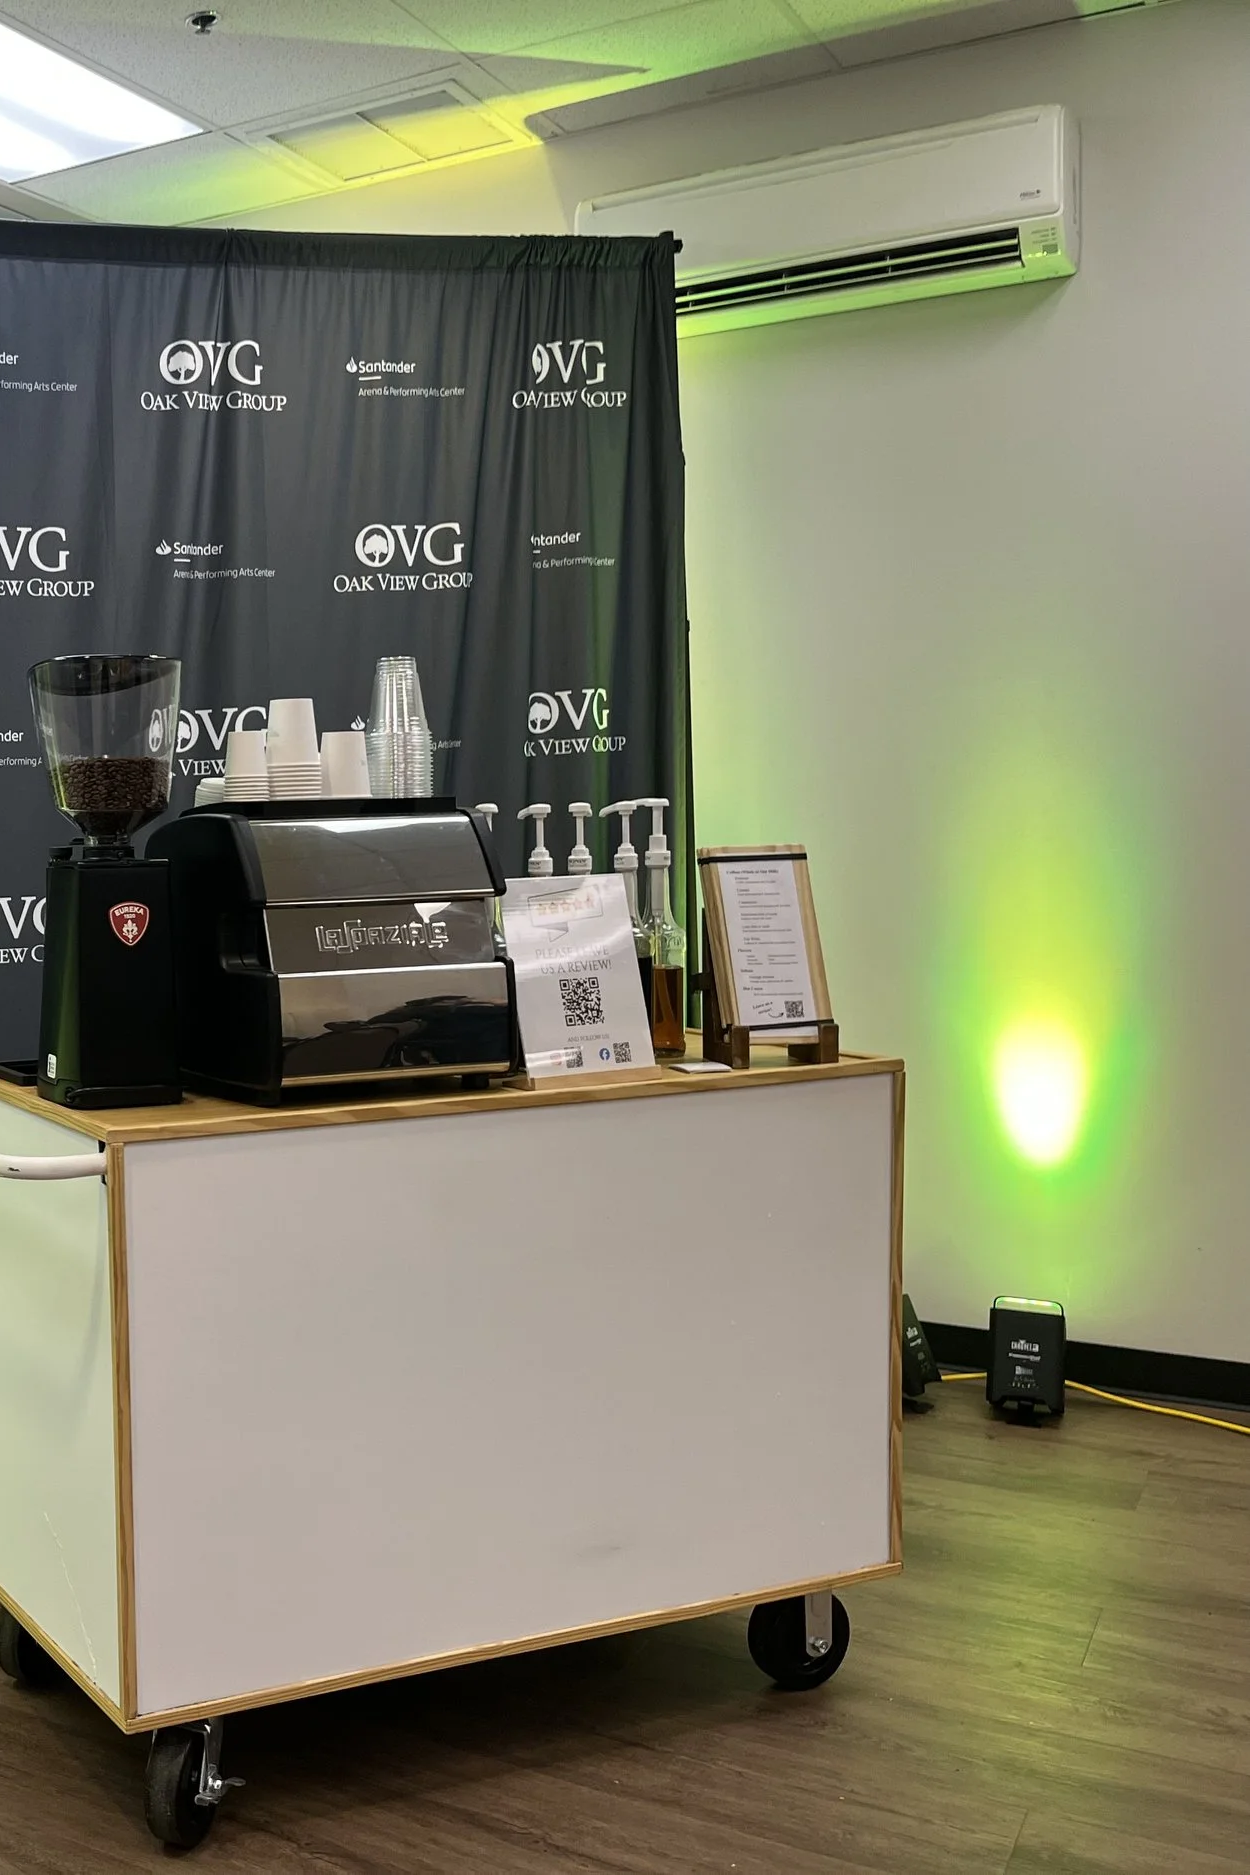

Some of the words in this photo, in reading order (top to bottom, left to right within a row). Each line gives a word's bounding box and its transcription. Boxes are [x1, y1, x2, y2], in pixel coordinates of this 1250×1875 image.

[160, 340, 263, 386] OVG
[358, 360, 416, 374] Santander
[34, 380, 50, 391] Arts
[51, 382, 78, 392] Center
[358, 387, 382, 397] Arena
[384, 388, 389, 396] &
[390, 386, 428, 398] Performing
[440, 386, 465, 398] Center
[140, 391, 179, 411] OAK
[182, 390, 224, 411] VIEW
[226, 391, 286, 412] GROUP
[174, 542, 224, 556] Santander
[354, 522, 464, 568] OVG
[194, 570, 238, 580] Performing
[239, 568, 254, 577] Arts
[254, 568, 276, 578] Center
[334, 574, 374, 592] OAK
[376, 574, 420, 591] VIEW
[422, 572, 473, 590] GROUP
[27, 578, 94, 597] GROUP
[528, 688, 609, 734] OVG
[539, 738, 590, 756] VIEW
[178, 759, 226, 776] VIEW
[114, 906, 144, 916] EUREKA
[568, 960, 612, 974] REVIEW!
